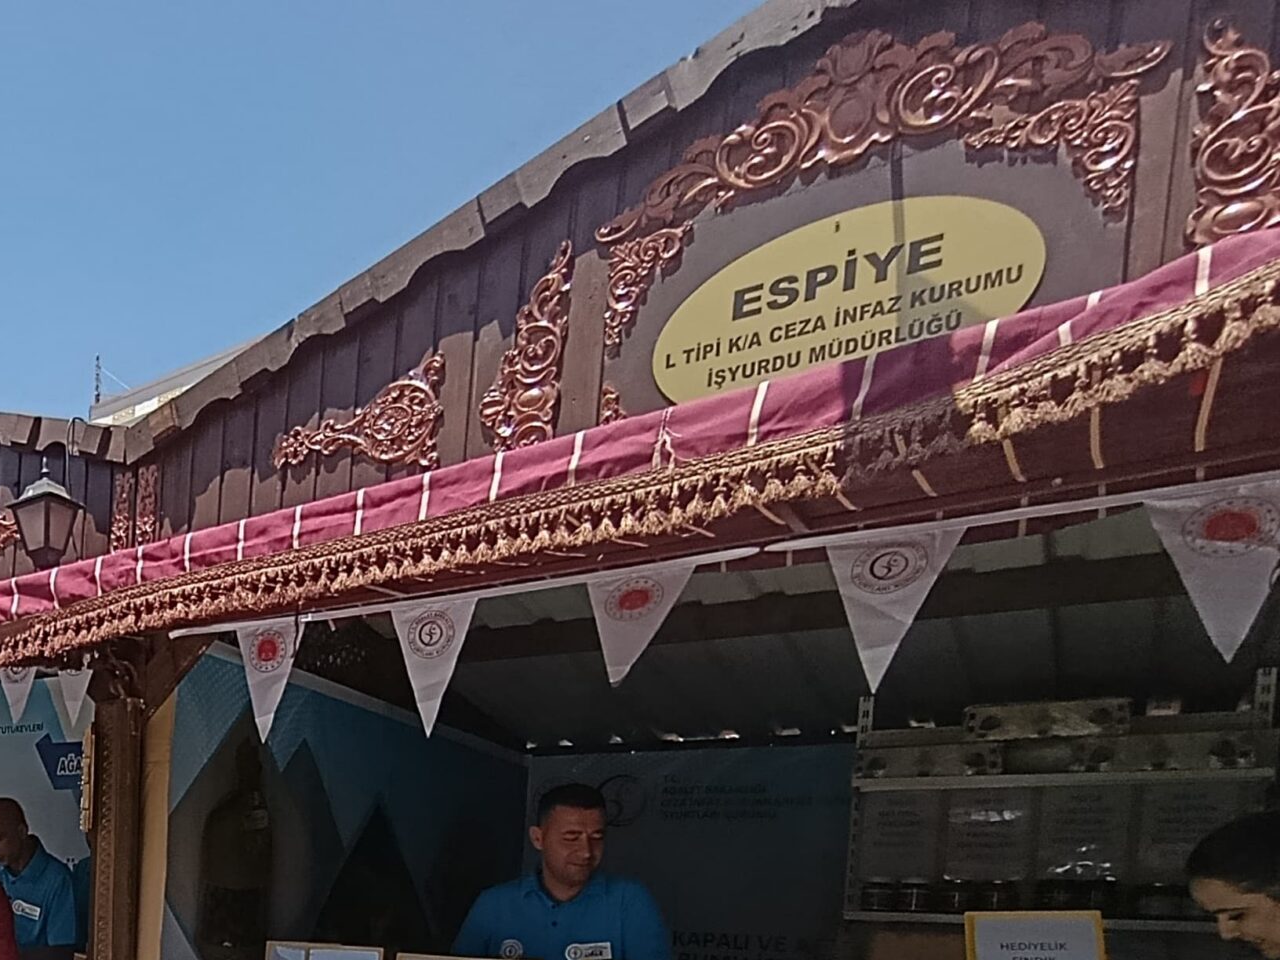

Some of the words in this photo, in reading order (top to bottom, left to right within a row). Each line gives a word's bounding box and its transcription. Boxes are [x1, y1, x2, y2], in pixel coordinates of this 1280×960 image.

[664, 353, 677, 370] L
[683, 336, 721, 366] TİPİ
[727, 331, 763, 355] K/A
[769, 314, 827, 344] CEZA
[834, 297, 902, 329] İNFAZ
[910, 263, 1024, 310] KURUMU
[732, 233, 945, 322] ESPİYE
[706, 351, 802, 389] İŞYURDU
[808, 309, 963, 364] MÜDÜRLÜĞÜ
